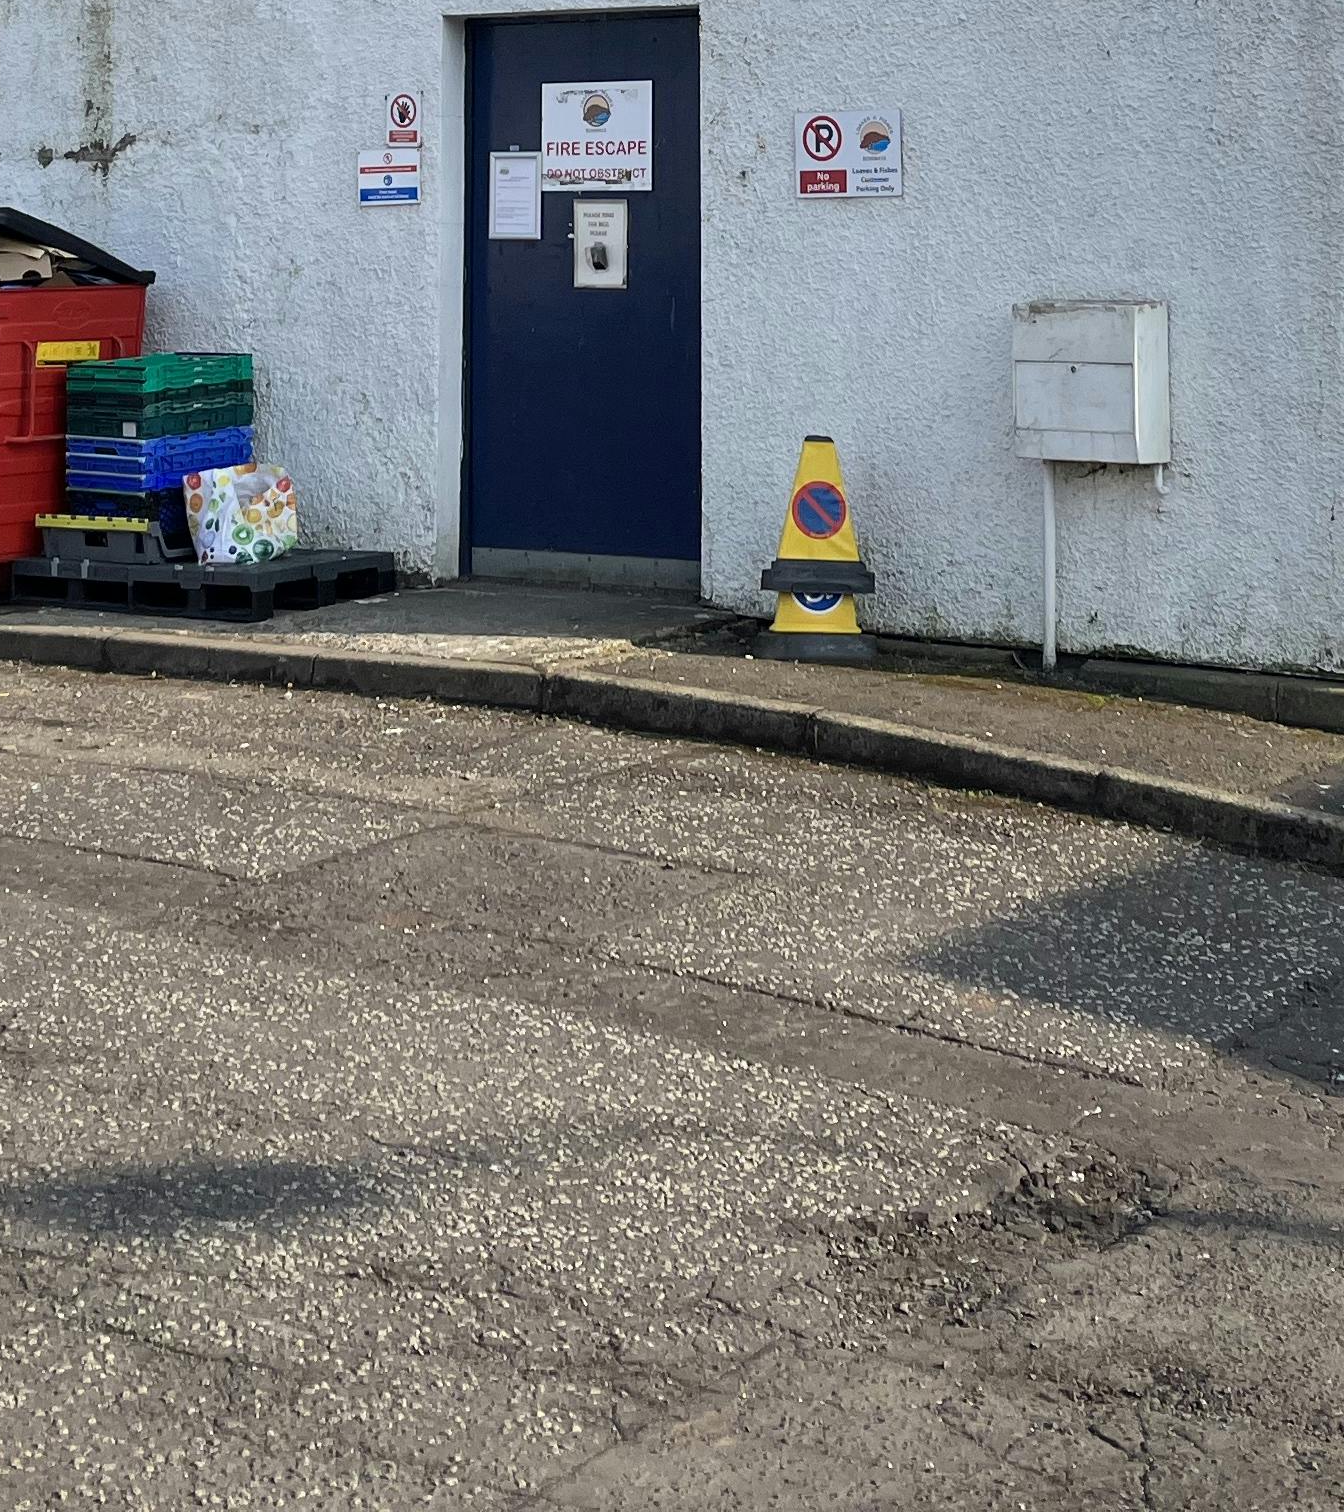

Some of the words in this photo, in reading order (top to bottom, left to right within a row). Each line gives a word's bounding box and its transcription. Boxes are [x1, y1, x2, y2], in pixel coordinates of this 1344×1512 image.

[546, 141, 581, 156] FIRE
[585, 140, 647, 155] ESCAPE
[547, 168, 562, 179] DO
[564, 168, 586, 179] NOT
[817, 172, 830, 181] No
[807, 182, 840, 193] parking
